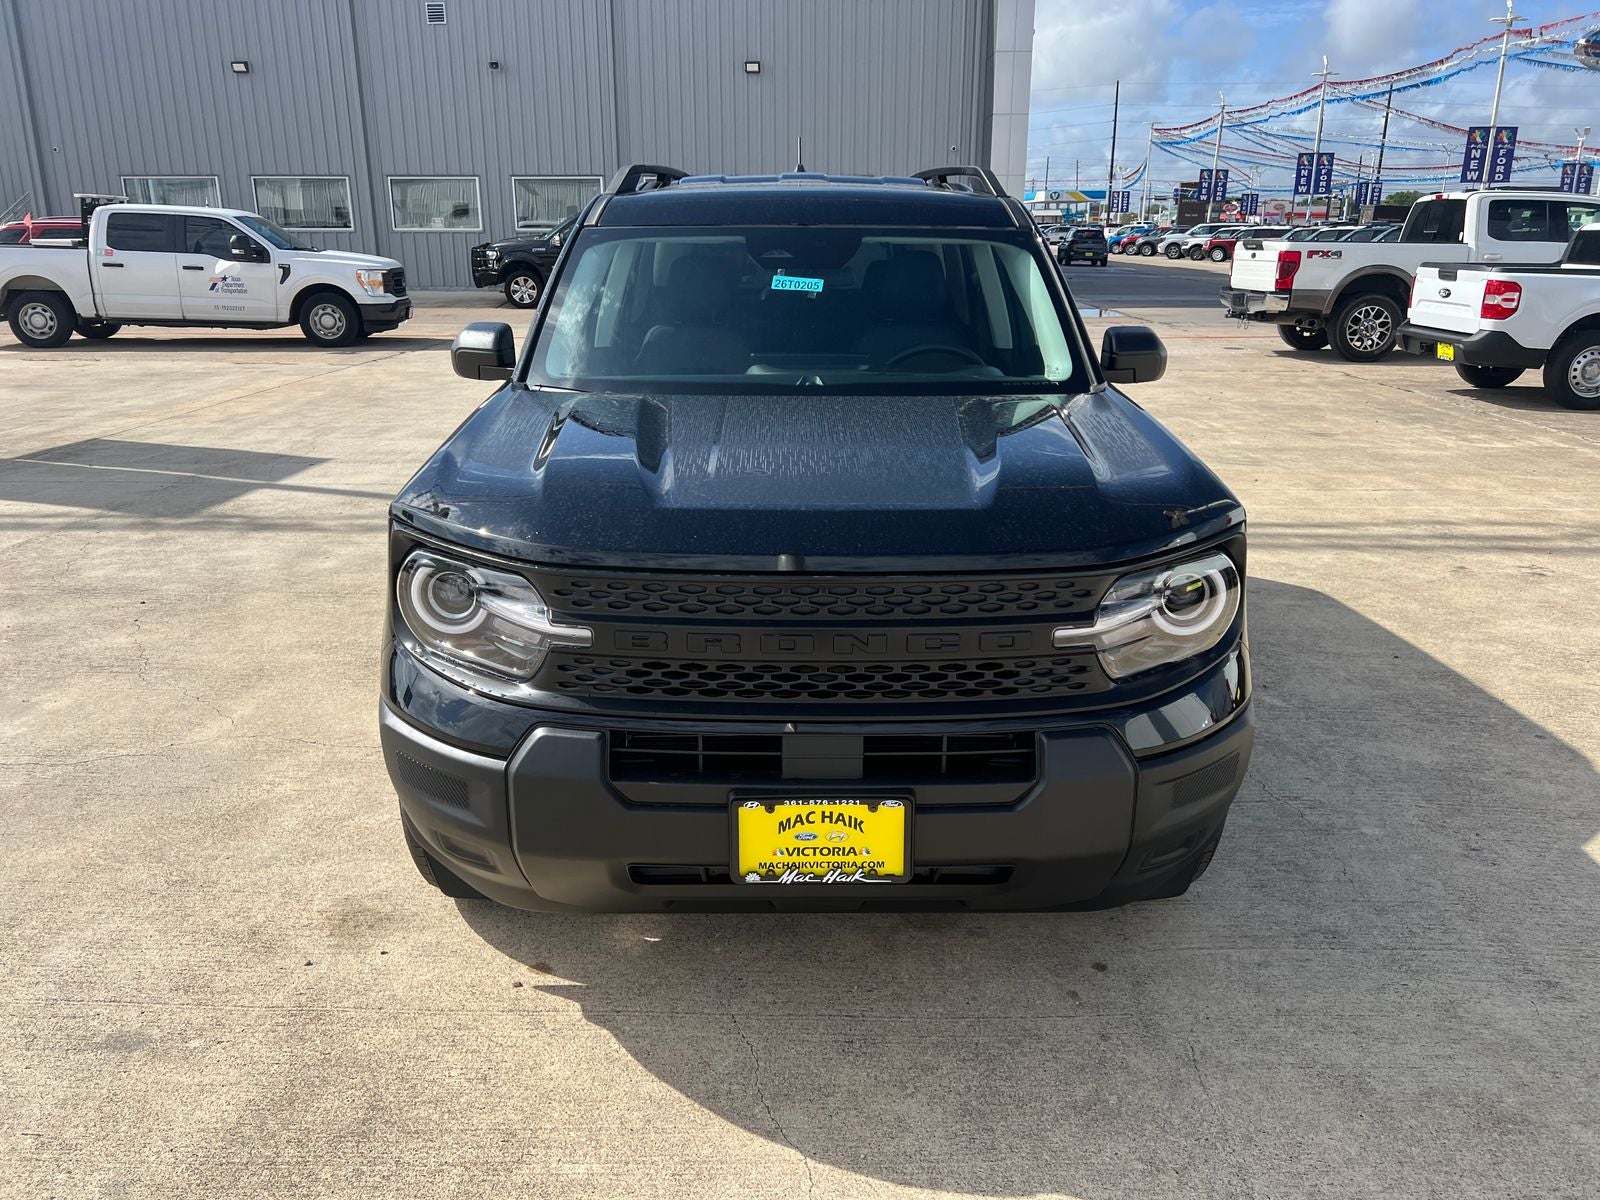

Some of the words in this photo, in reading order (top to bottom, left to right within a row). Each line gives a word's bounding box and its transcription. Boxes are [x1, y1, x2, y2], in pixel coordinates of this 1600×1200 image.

[1466, 149, 1481, 180] NEW
[1494, 149, 1508, 180] FORD
[1298, 169, 1309, 193] NEW
[1318, 169, 1328, 193] FORD
[1563, 177, 1571, 191] NE
[1200, 182, 1208, 201] NEW
[1306, 250, 1343, 260] FX4
[775, 279, 820, 290] 26T0205
[614, 630, 1032, 654] BRONCO
[778, 811, 816, 835] MAC
[821, 811, 865, 834] HAIK
[796, 832, 816, 841] Ford
[785, 847, 858, 857] VICTORIA
[758, 861, 885, 870] MACHAIKVICTORIA.COM
[777, 868, 816, 884] Mac
[822, 868, 866, 884] Haik
